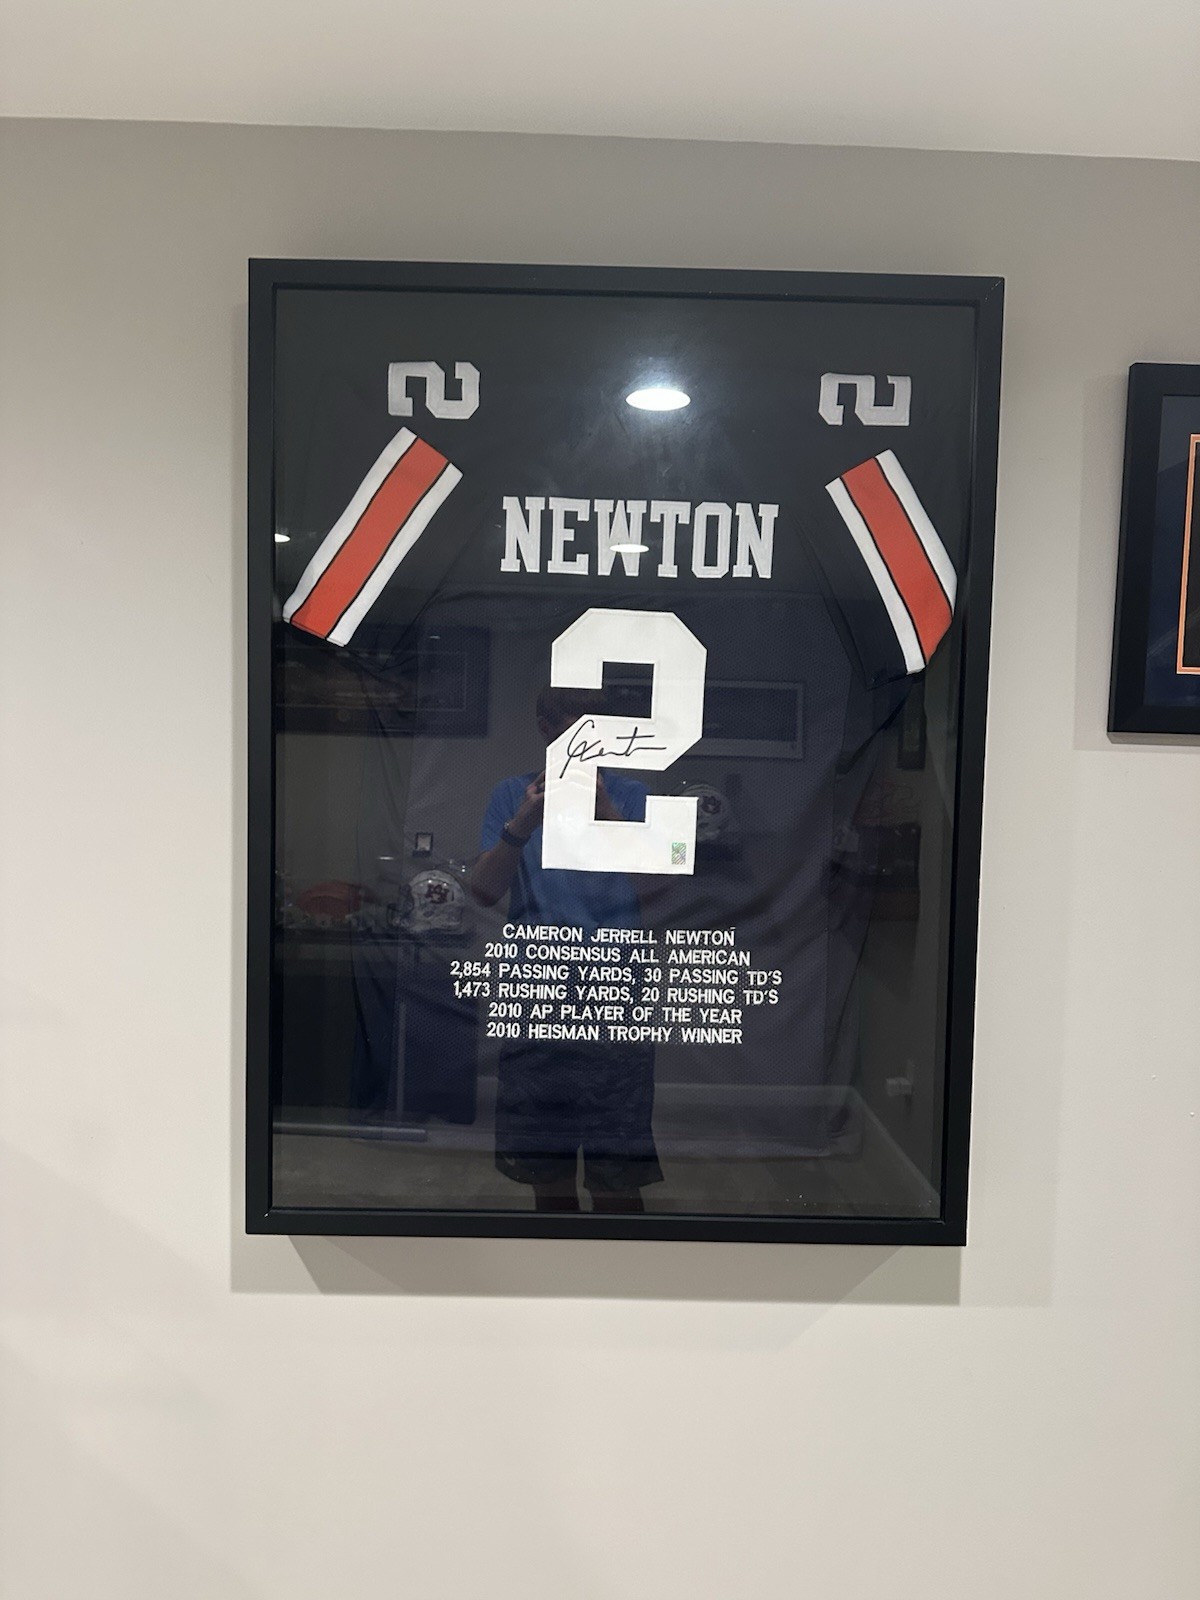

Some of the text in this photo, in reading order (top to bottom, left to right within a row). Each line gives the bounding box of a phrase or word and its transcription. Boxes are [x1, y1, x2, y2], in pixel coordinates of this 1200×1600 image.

[388, 361, 480, 420] 2
[818, 373, 912, 427] 2
[500, 495, 780, 579] NEWTON
[541, 608, 707, 876] 2
[503, 923, 735, 946] CAMERON JERRELL NEWTON
[485, 943, 750, 966] 2010 CONSENSUS ALL AMERICAN
[450, 961, 782, 985] 2,854 PASSING YARDS, 30 PASSING TD'S
[454, 981, 779, 1005] 1,473 RUSHING YARDS, 20 RUSHING TD'S
[489, 1002, 742, 1024] 2010 AP PLAYER OF THE YEAR
[487, 1022, 742, 1044] 2010 HEISMAN TROPHY WINNER
